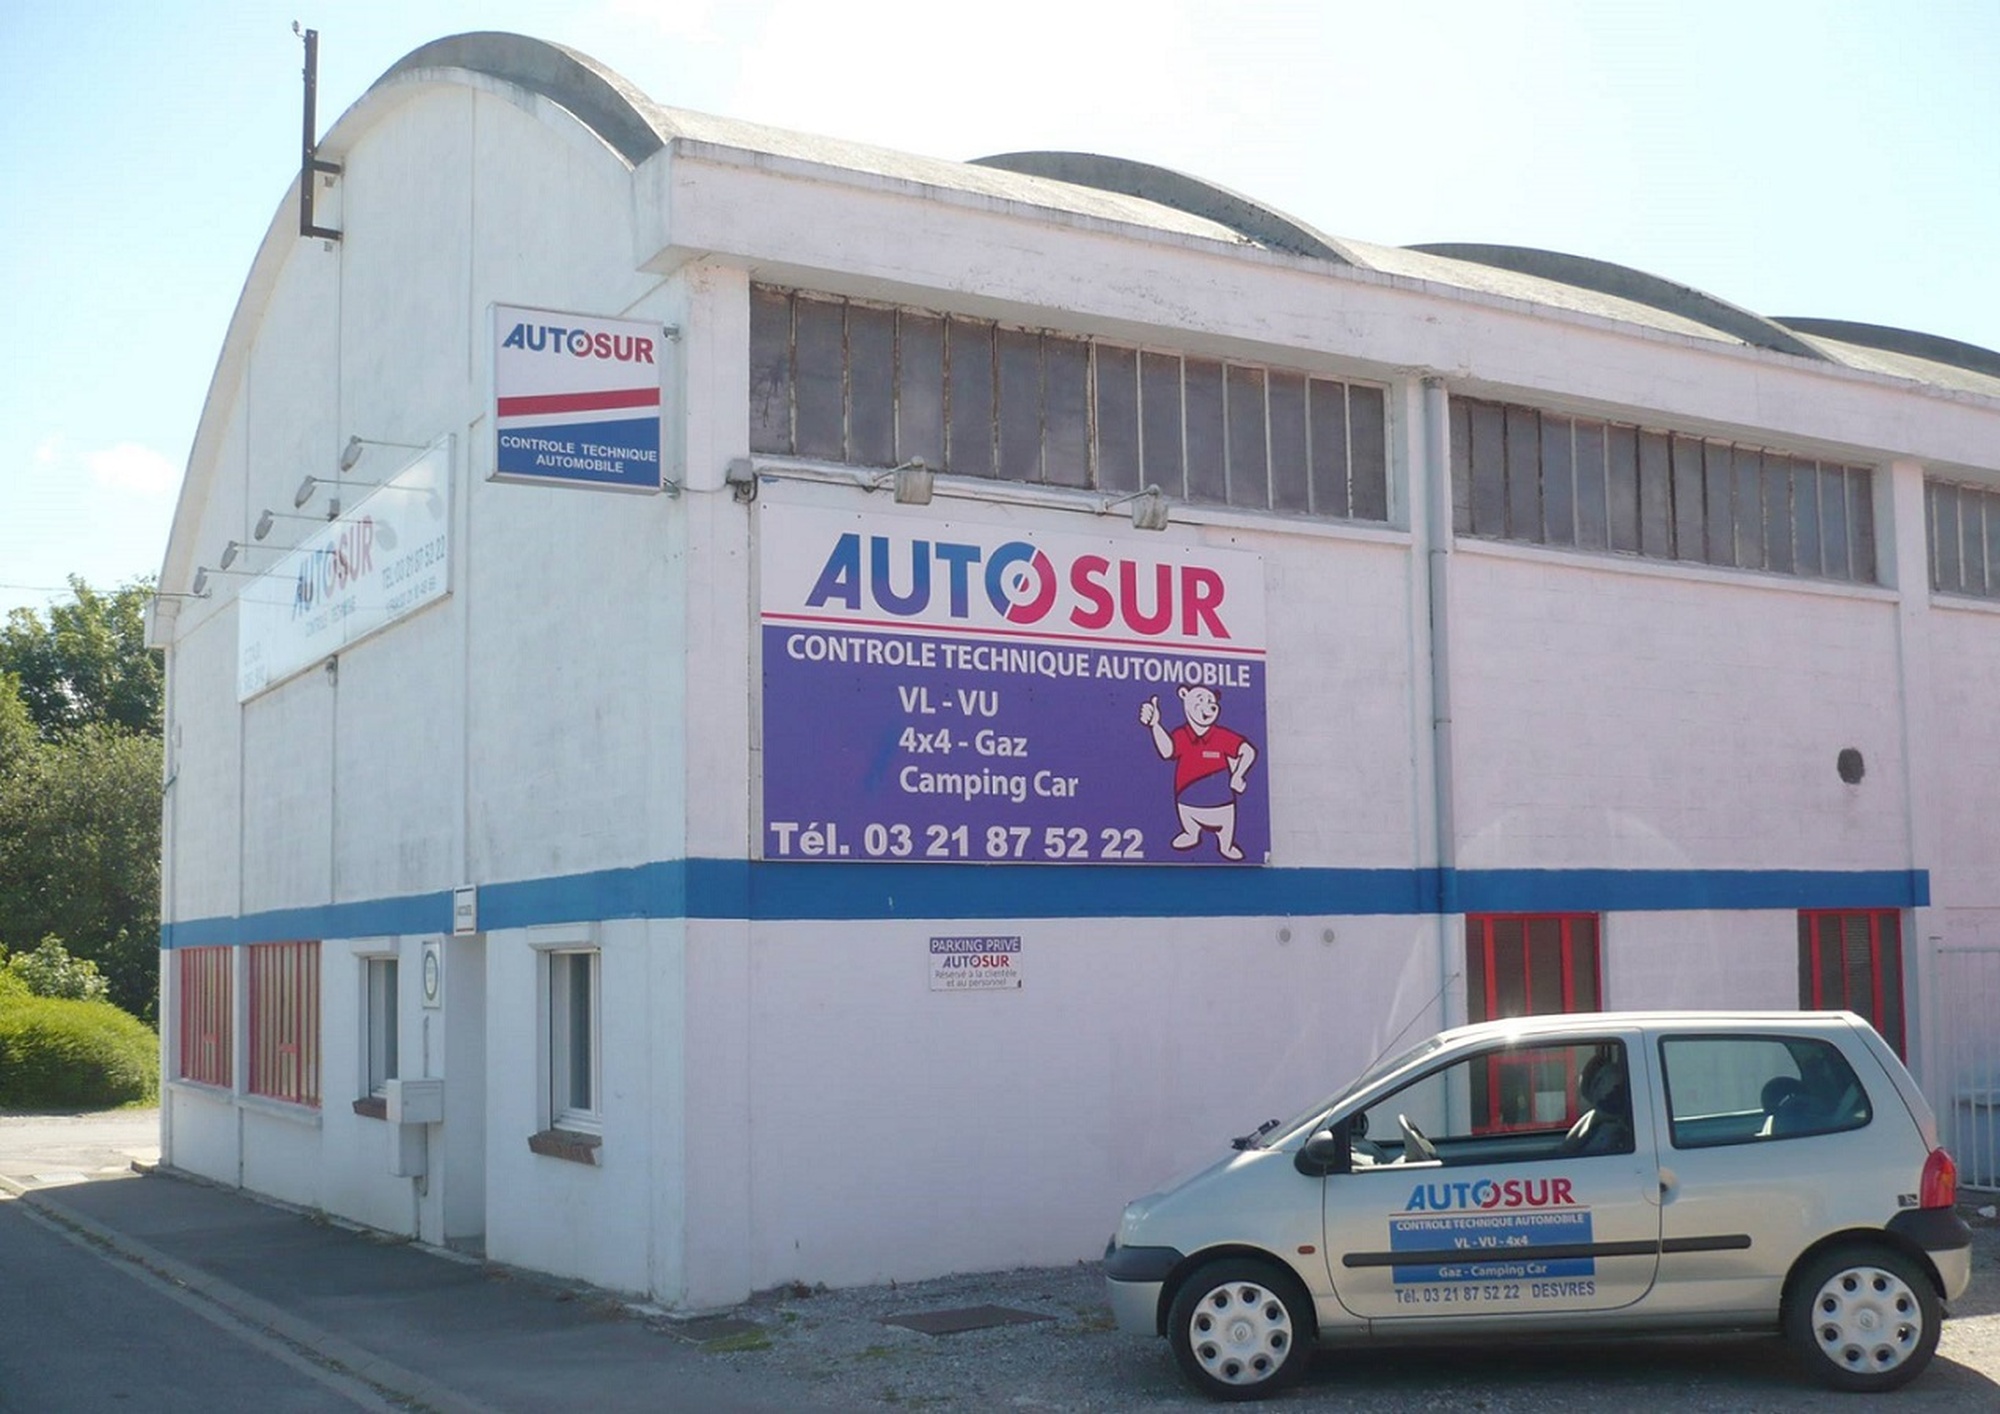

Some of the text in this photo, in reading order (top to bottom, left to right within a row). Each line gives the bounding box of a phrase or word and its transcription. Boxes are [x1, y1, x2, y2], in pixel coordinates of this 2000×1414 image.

[502, 323, 654, 364] AUTOSUR
[501, 436, 657, 461] CONTROLE TECHNIQUE
[536, 454, 624, 474] AUTOMOBILE
[292, 515, 373, 622] AUTOSUR
[804, 532, 1231, 639] AUTOSUR
[787, 634, 1250, 687] CONTROLE TECHNIQUE AUTOMOBILE
[898, 686, 936, 714] VL
[958, 689, 998, 717] VU
[899, 727, 952, 754] 4x4
[975, 729, 1028, 757] Gaz
[900, 766, 1079, 803] Camping Car
[770, 822, 1144, 858] Tél. 03 21 87 52 22
[931, 939, 983, 952] PARKING
[943, 955, 1009, 968] AUTOSUR
[1406, 1178, 1576, 1211] AUTOSUR
[1397, 1214, 1584, 1231] CONTROLE TECHNIQUE AUTOMOBILE
[1454, 1237, 1470, 1249] VL
[1479, 1236, 1497, 1247] VU
[1506, 1235, 1528, 1246] 4x4
[1439, 1266, 1462, 1278] Gaz
[1470, 1264, 1525, 1278] Camping
[1527, 1263, 1547, 1274] Car
[1395, 1281, 1596, 1303] Tél. 03 21 87 52 22 DESVRES
